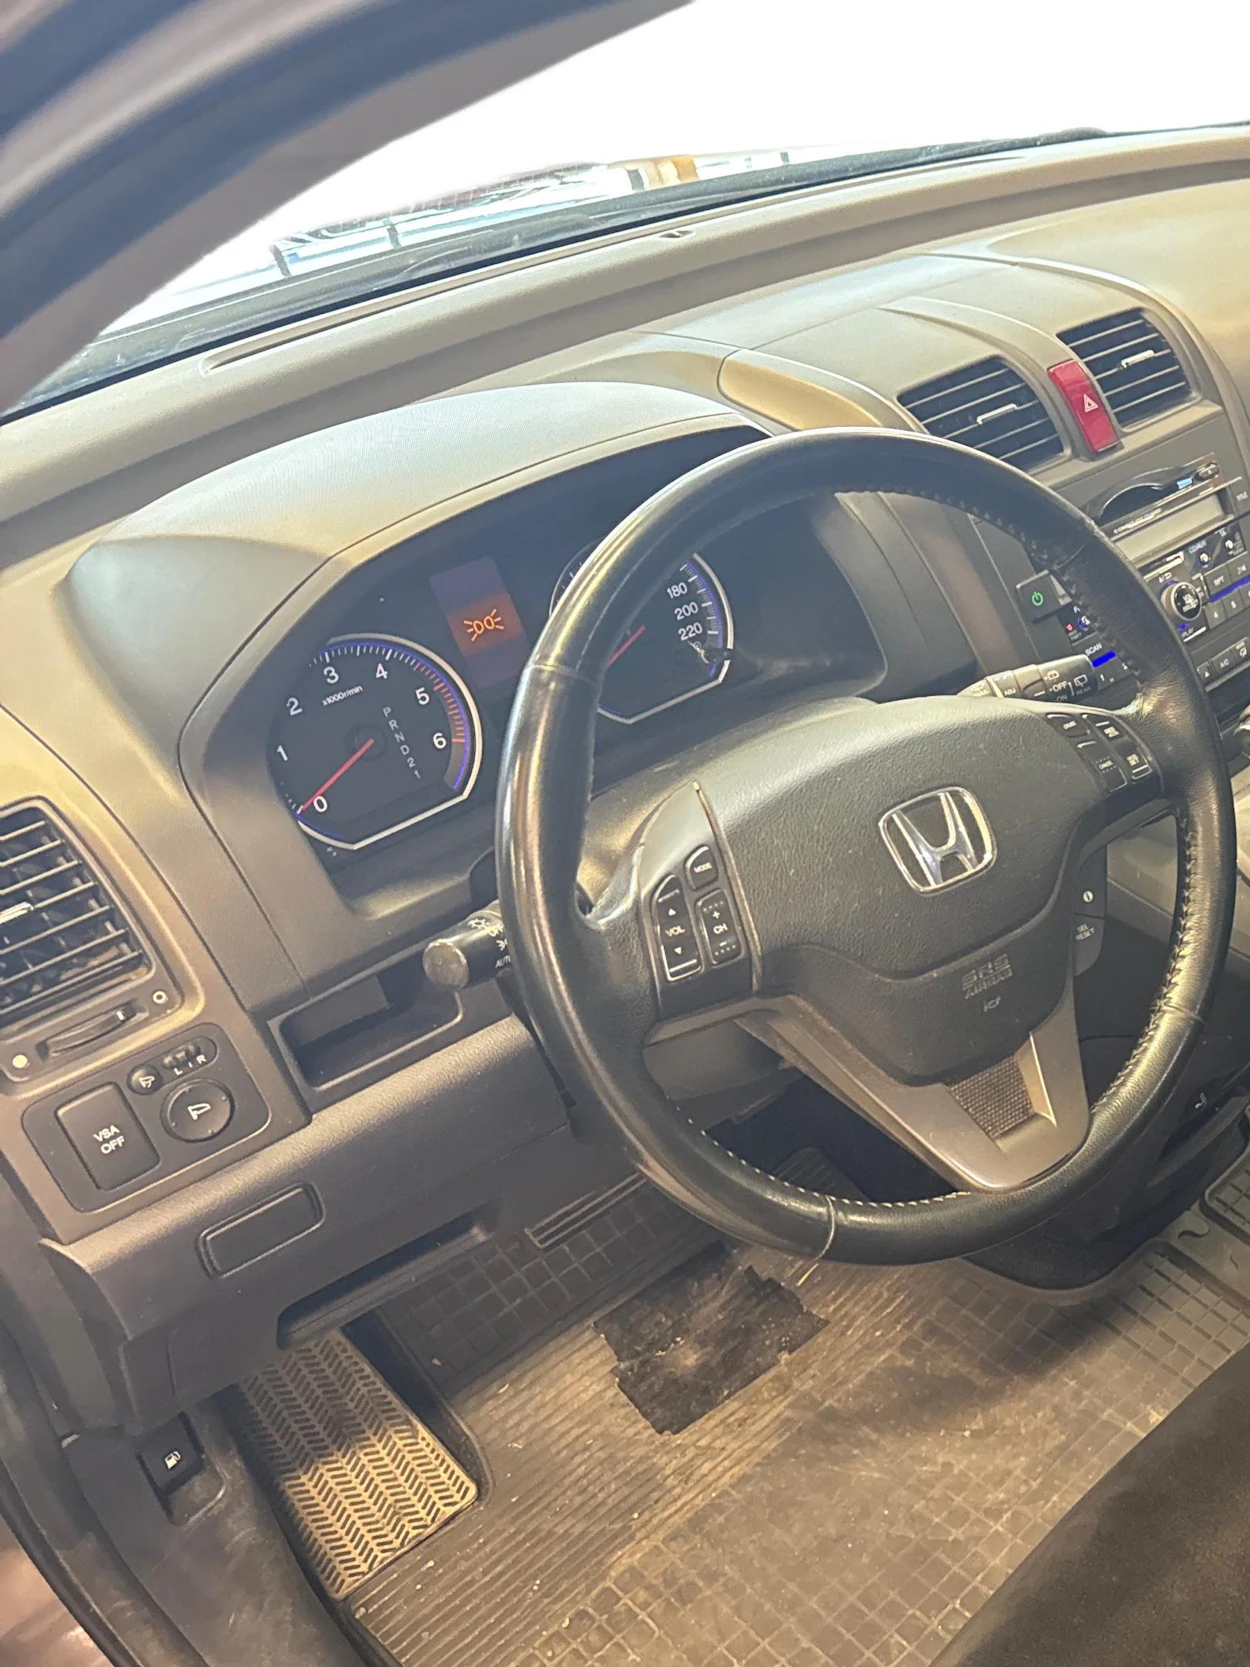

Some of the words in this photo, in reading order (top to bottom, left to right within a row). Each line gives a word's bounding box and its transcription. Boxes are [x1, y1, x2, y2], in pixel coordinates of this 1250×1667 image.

[666, 582, 688, 599] 180
[674, 601, 699, 621] 200
[678, 621, 703, 641] 220
[1084, 642, 1103, 656] SCAN
[323, 666, 339, 684] 3
[375, 662, 389, 680] 4
[1052, 681, 1068, 693] OFF
[415, 687, 430, 705] 5
[286, 697, 303, 716] 2
[432, 732, 447, 749] 6
[277, 745, 288, 761] 1
[312, 795, 328, 813] 0
[665, 925, 685, 937] VOL
[713, 923, 728, 935] CH
[196, 1054, 207, 1065] R
[174, 1067, 183, 1076] L
[93, 1125, 120, 1142] VSA
[100, 1135, 125, 1154] OFF
